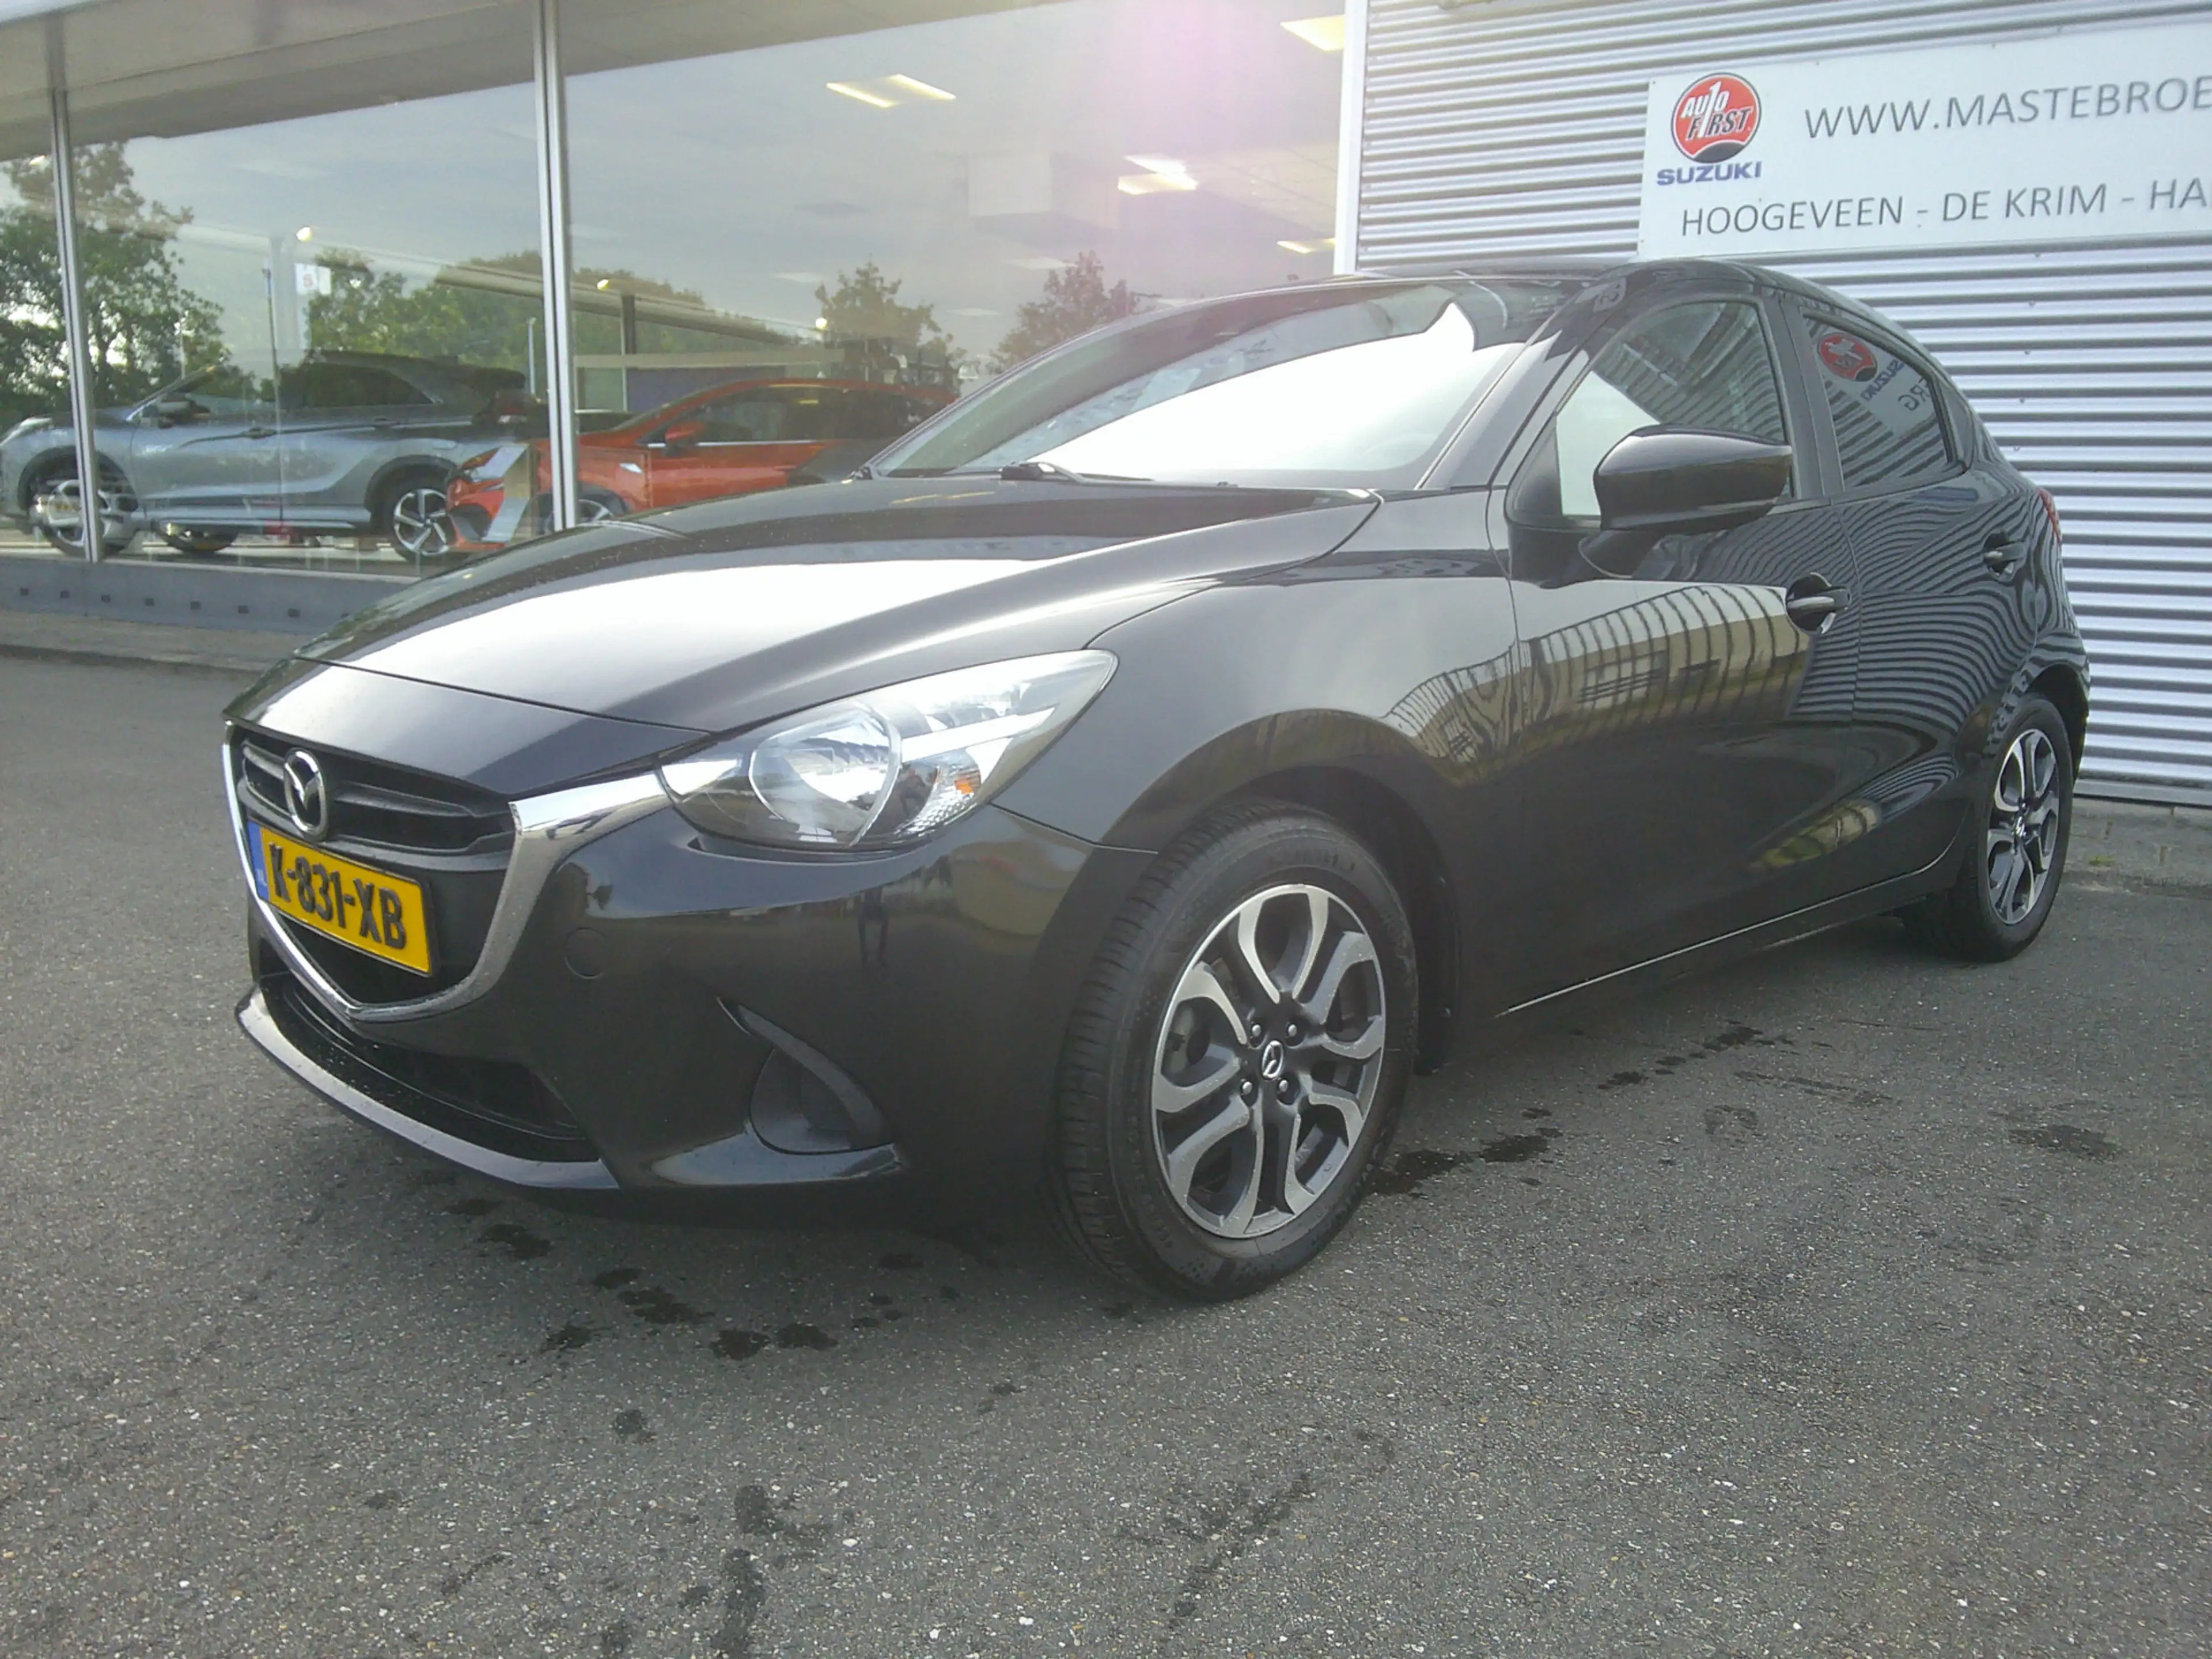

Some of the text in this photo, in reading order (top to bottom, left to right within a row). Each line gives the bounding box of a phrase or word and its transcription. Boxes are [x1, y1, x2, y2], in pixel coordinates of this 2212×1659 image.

[1804, 75, 2212, 138] WWW.MASTEBROE
[1656, 161, 1762, 186] SUZUKI
[1682, 196, 1903, 236] HOOGEVEEN
[1942, 190, 1991, 222] DE
[2005, 183, 2107, 218] KRIM
[2149, 177, 2212, 210] HA
[268, 842, 407, 949] K-831-XB
